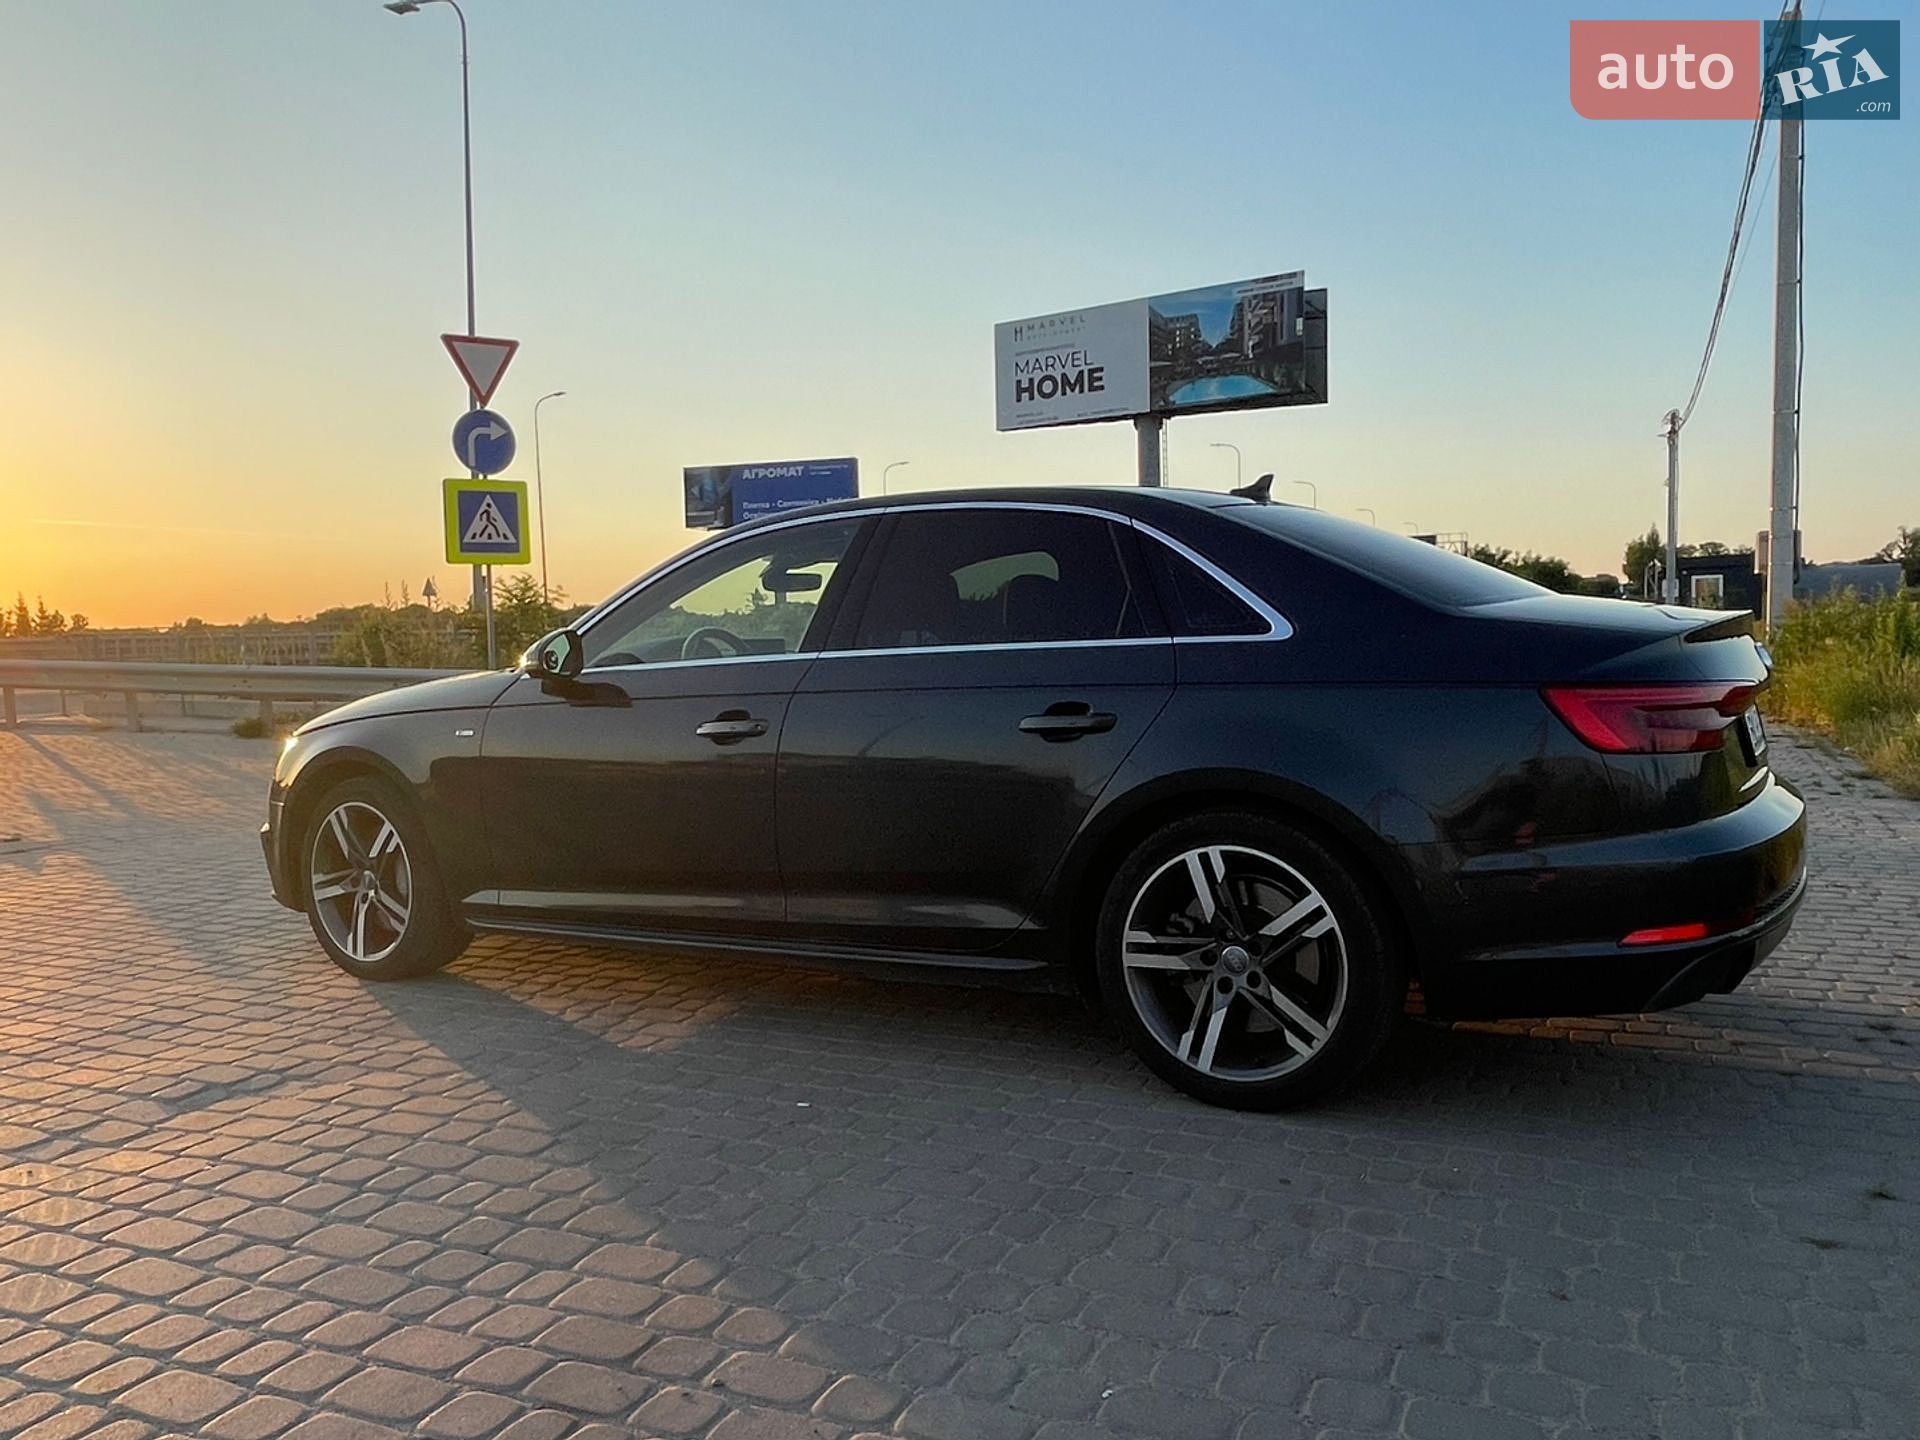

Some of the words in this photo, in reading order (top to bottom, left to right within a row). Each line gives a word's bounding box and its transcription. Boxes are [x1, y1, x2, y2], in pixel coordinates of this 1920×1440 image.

[1015, 350, 1094, 377] MARVEL
[1016, 366, 1105, 403] HOME
[742, 464, 804, 480] АГРОМАТ
